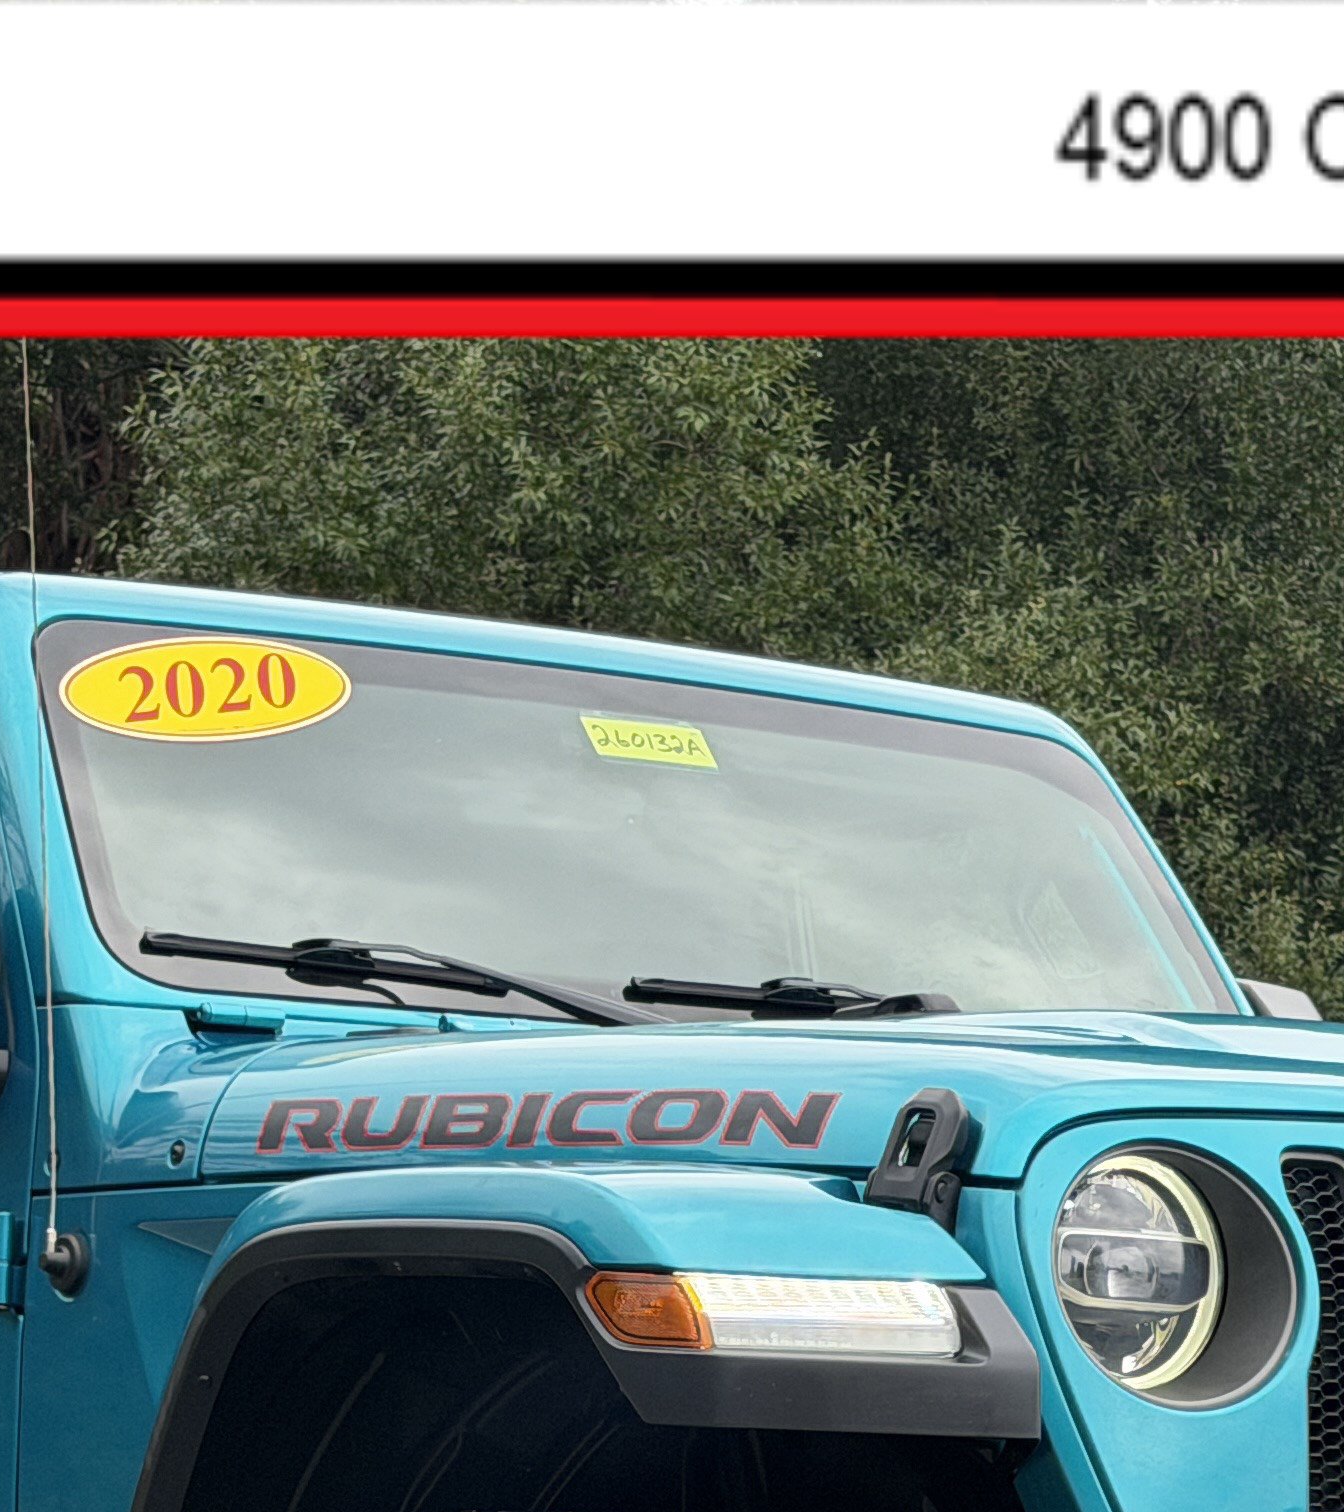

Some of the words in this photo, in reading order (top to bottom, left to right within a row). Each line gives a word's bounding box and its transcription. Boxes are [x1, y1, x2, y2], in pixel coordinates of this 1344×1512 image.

[118, 652, 296, 723] 2020
[591, 724, 706, 757] 260132A
[256, 1089, 843, 1155] RUBICON
